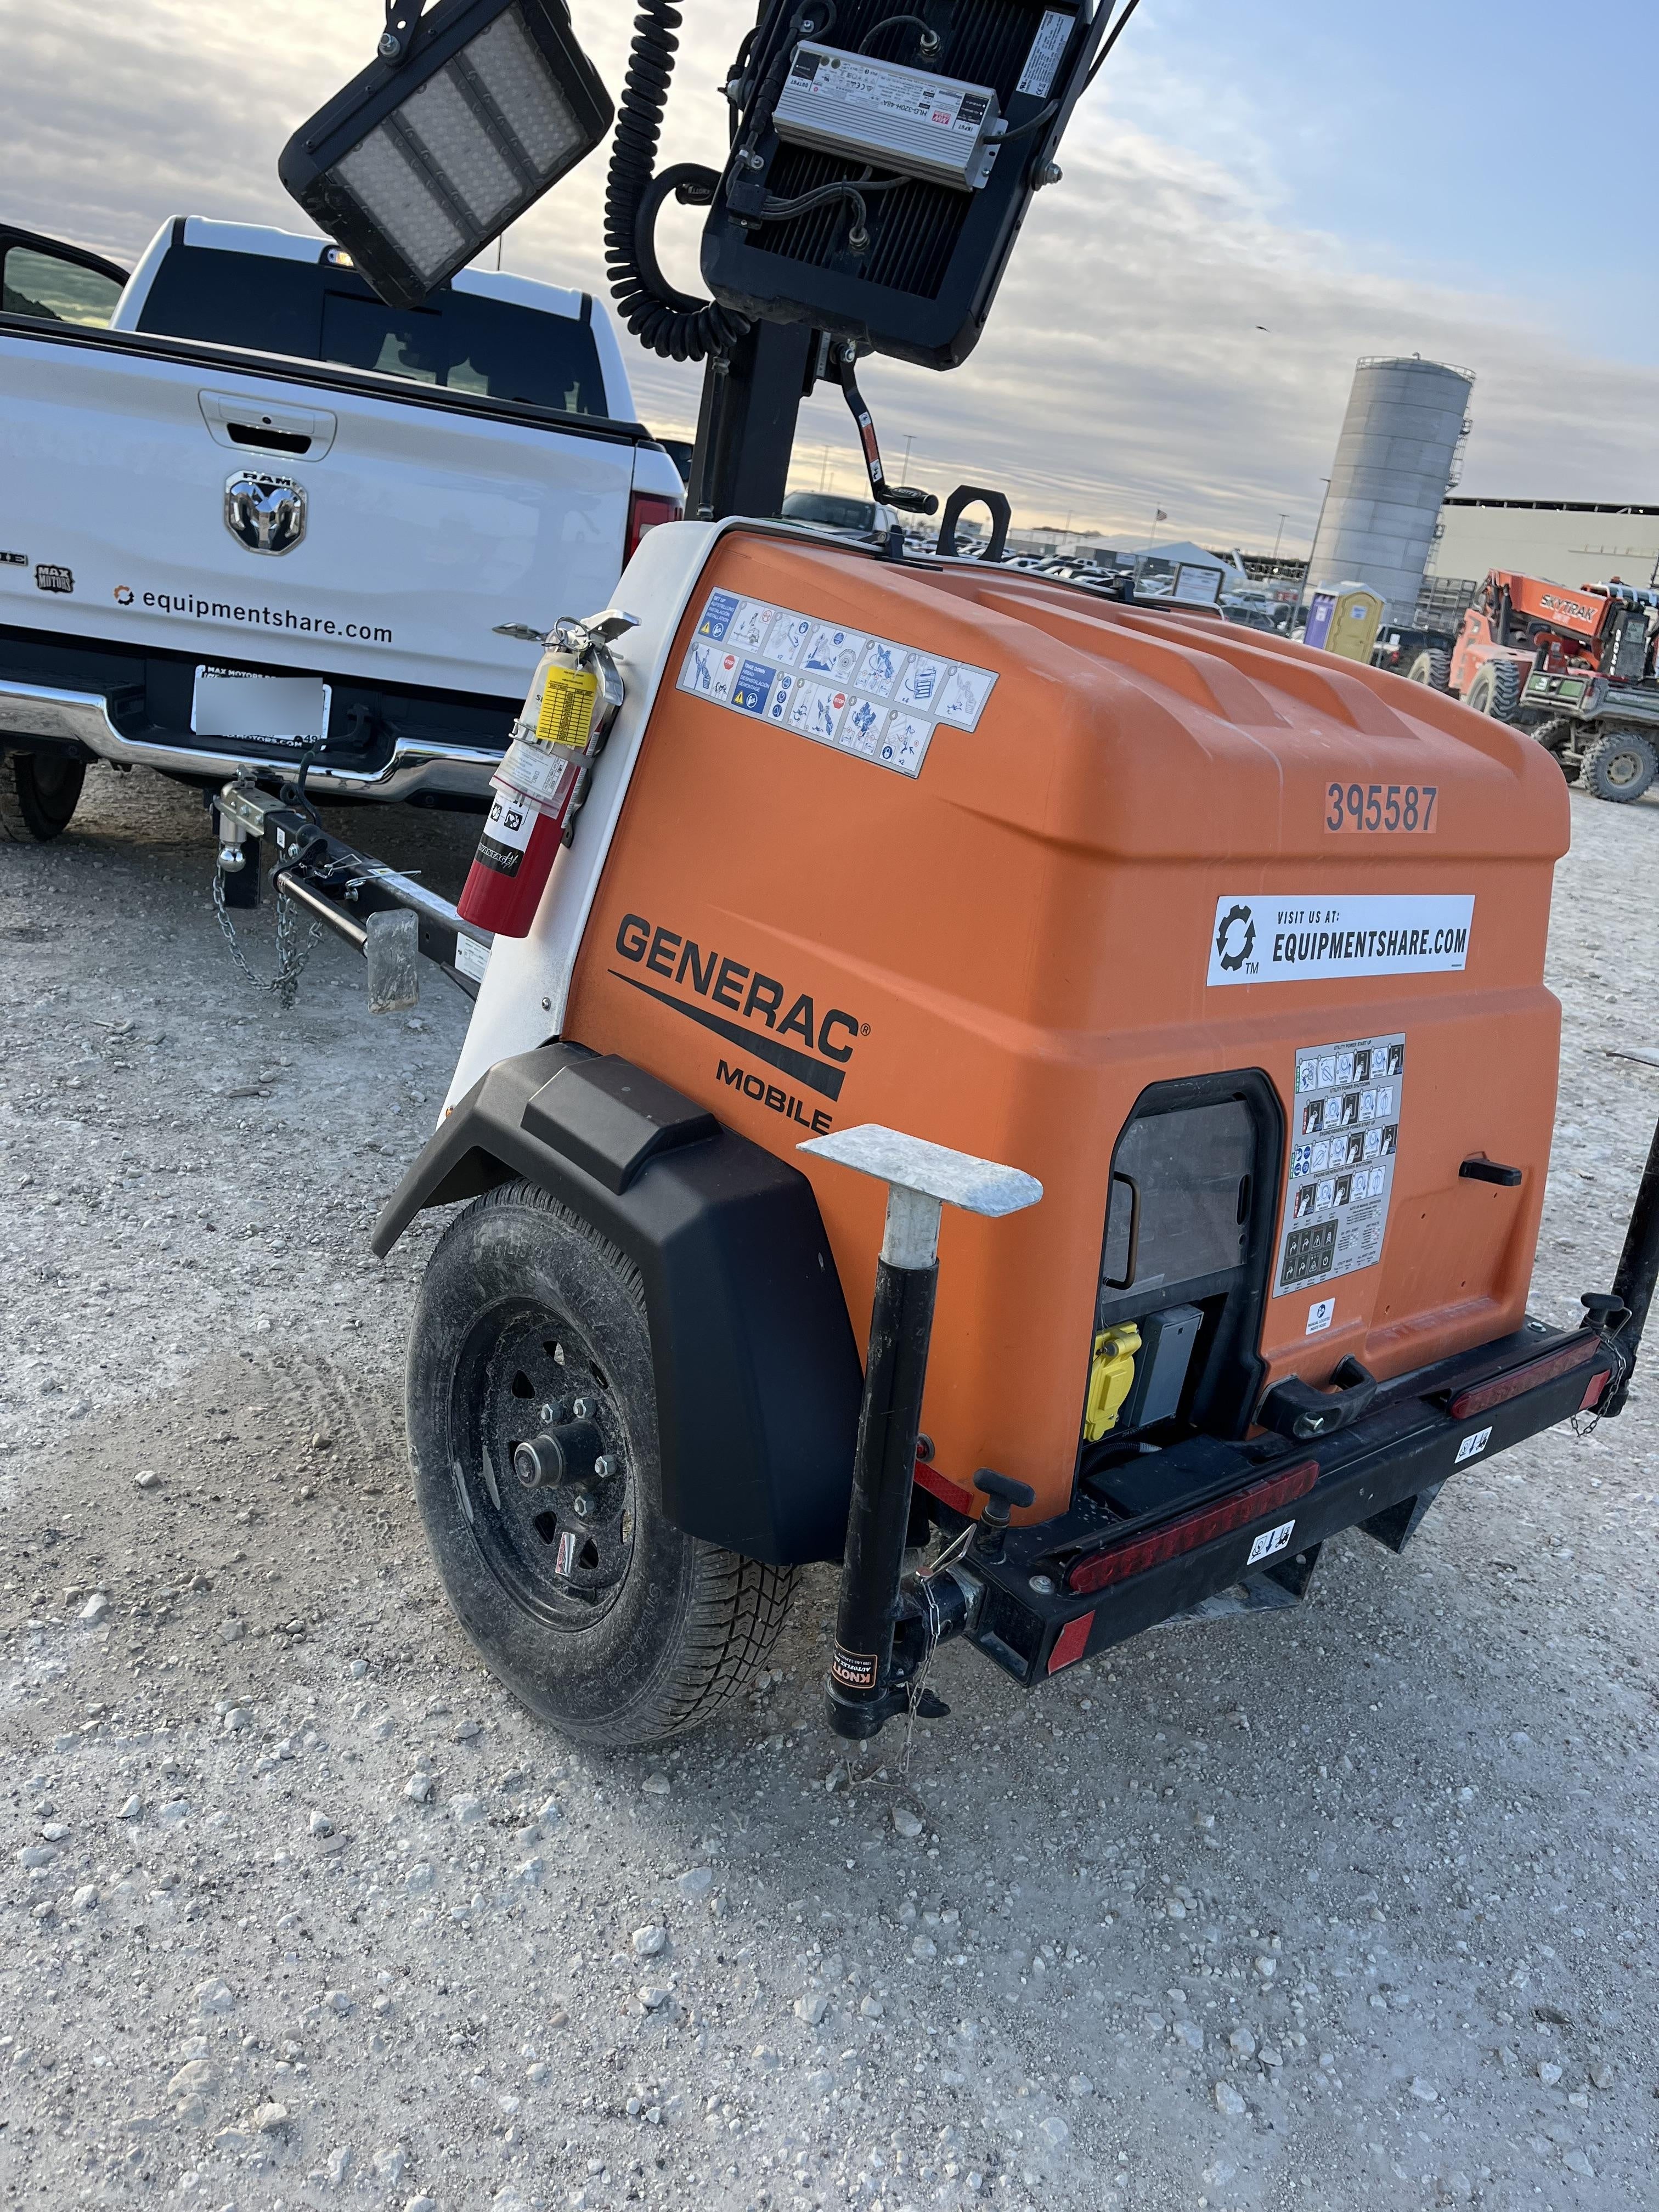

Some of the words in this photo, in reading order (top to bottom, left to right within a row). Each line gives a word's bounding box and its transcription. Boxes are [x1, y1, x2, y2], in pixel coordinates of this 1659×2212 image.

[243, 472, 291, 486] RAM
[38, 567, 69, 577] MAX
[39, 575, 71, 591] MOTORS
[143, 589, 393, 644] equipmentshare.com
[1540, 593, 1598, 623] SKYTRAK
[1327, 783, 1437, 832] 395587
[1277, 911, 1305, 924] VISIT
[1309, 911, 1322, 923] US
[1325, 910, 1340, 923] AT:
[1272, 928, 1467, 963] EQUIPMENTSHARE.COM
[1245, 962, 1260, 975] TM
[715, 1059, 833, 1136] MOBILE
[832, 1661, 871, 1683] KNOTT
[839, 1661, 871, 1672] AUTOFLEX
